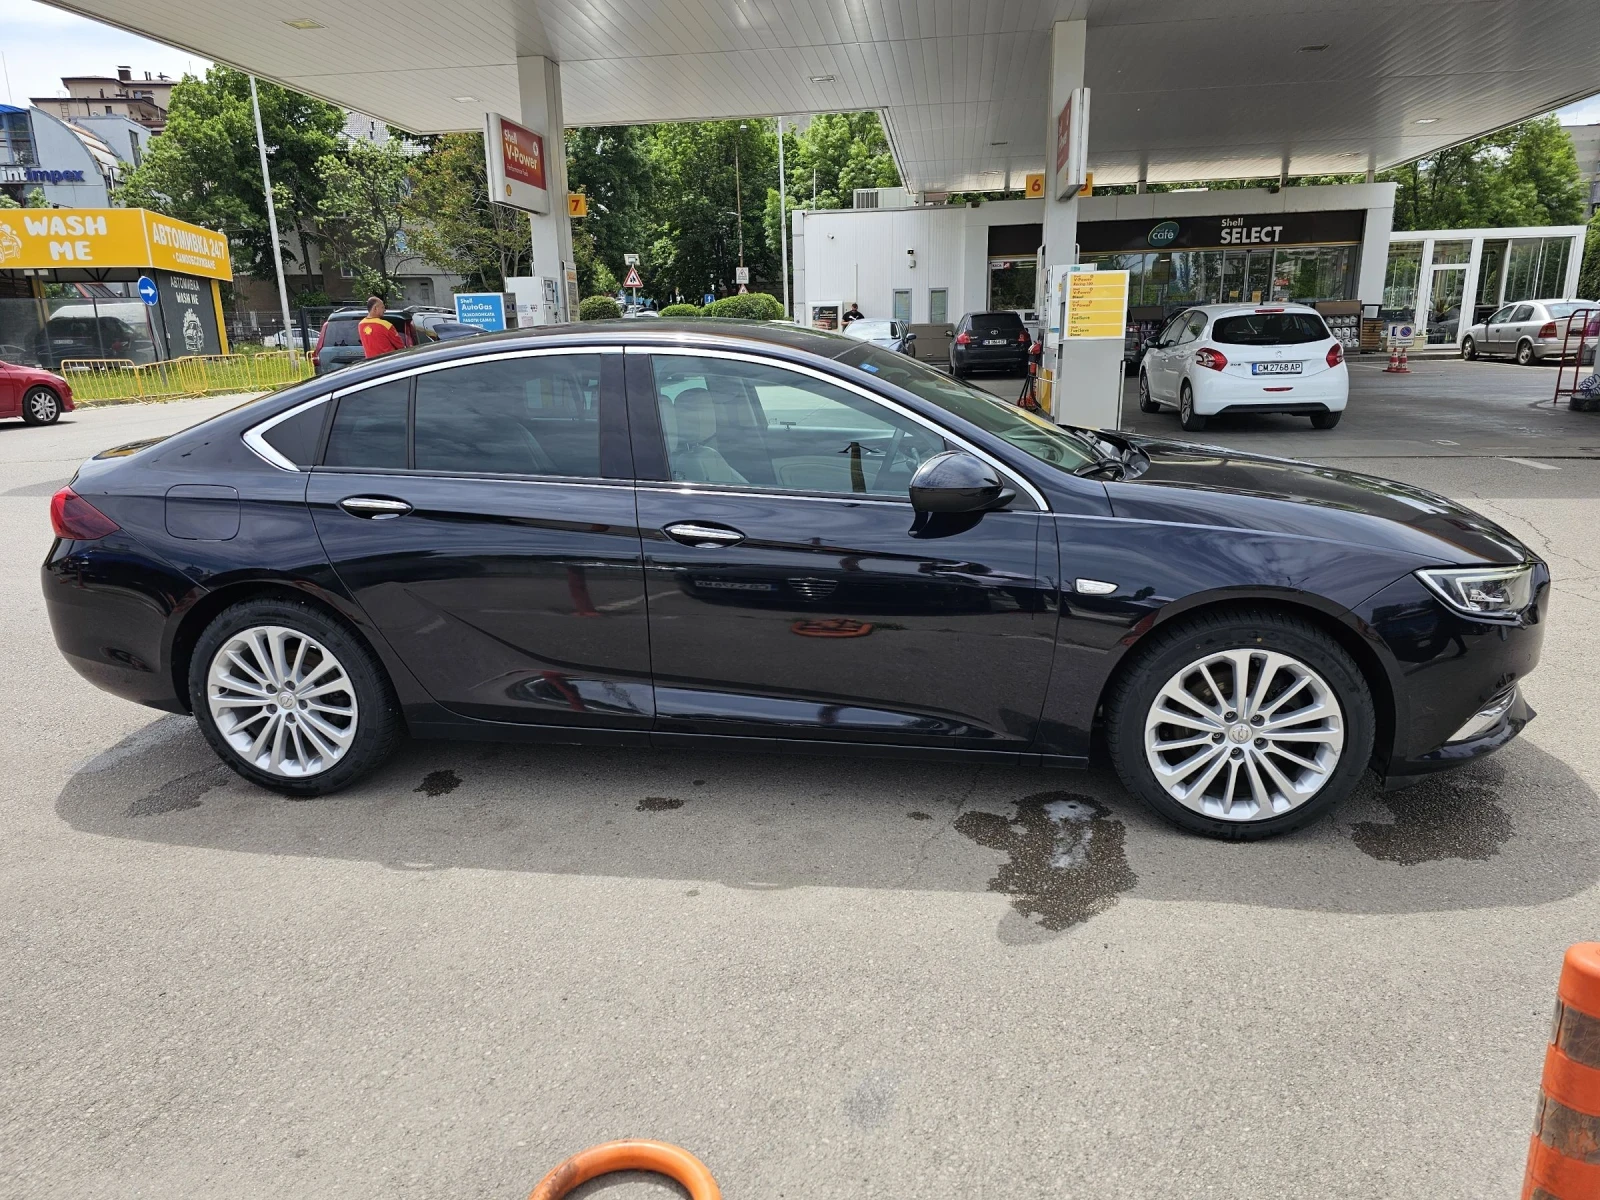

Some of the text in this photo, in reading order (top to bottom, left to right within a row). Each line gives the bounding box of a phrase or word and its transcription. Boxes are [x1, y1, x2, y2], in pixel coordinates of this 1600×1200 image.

[504, 129, 518, 145] Shell
[506, 142, 538, 170] V-Power
[1, 167, 86, 186] intimpex
[1032, 179, 1042, 192] 6
[571, 199, 581, 212] 7
[24, 216, 107, 236] WASH
[1221, 218, 1243, 227] Shell
[153, 222, 225, 259] АВТОМИВКА 24/7
[1152, 228, 1174, 240] café
[1220, 226, 1283, 244] SELECT
[50, 241, 93, 261] ME
[170, 276, 200, 291] АВТОМИВКА
[176, 291, 191, 304] WASH
[462, 303, 493, 311] AutoGas
[1257, 363, 1301, 372] CM 2768 AP
